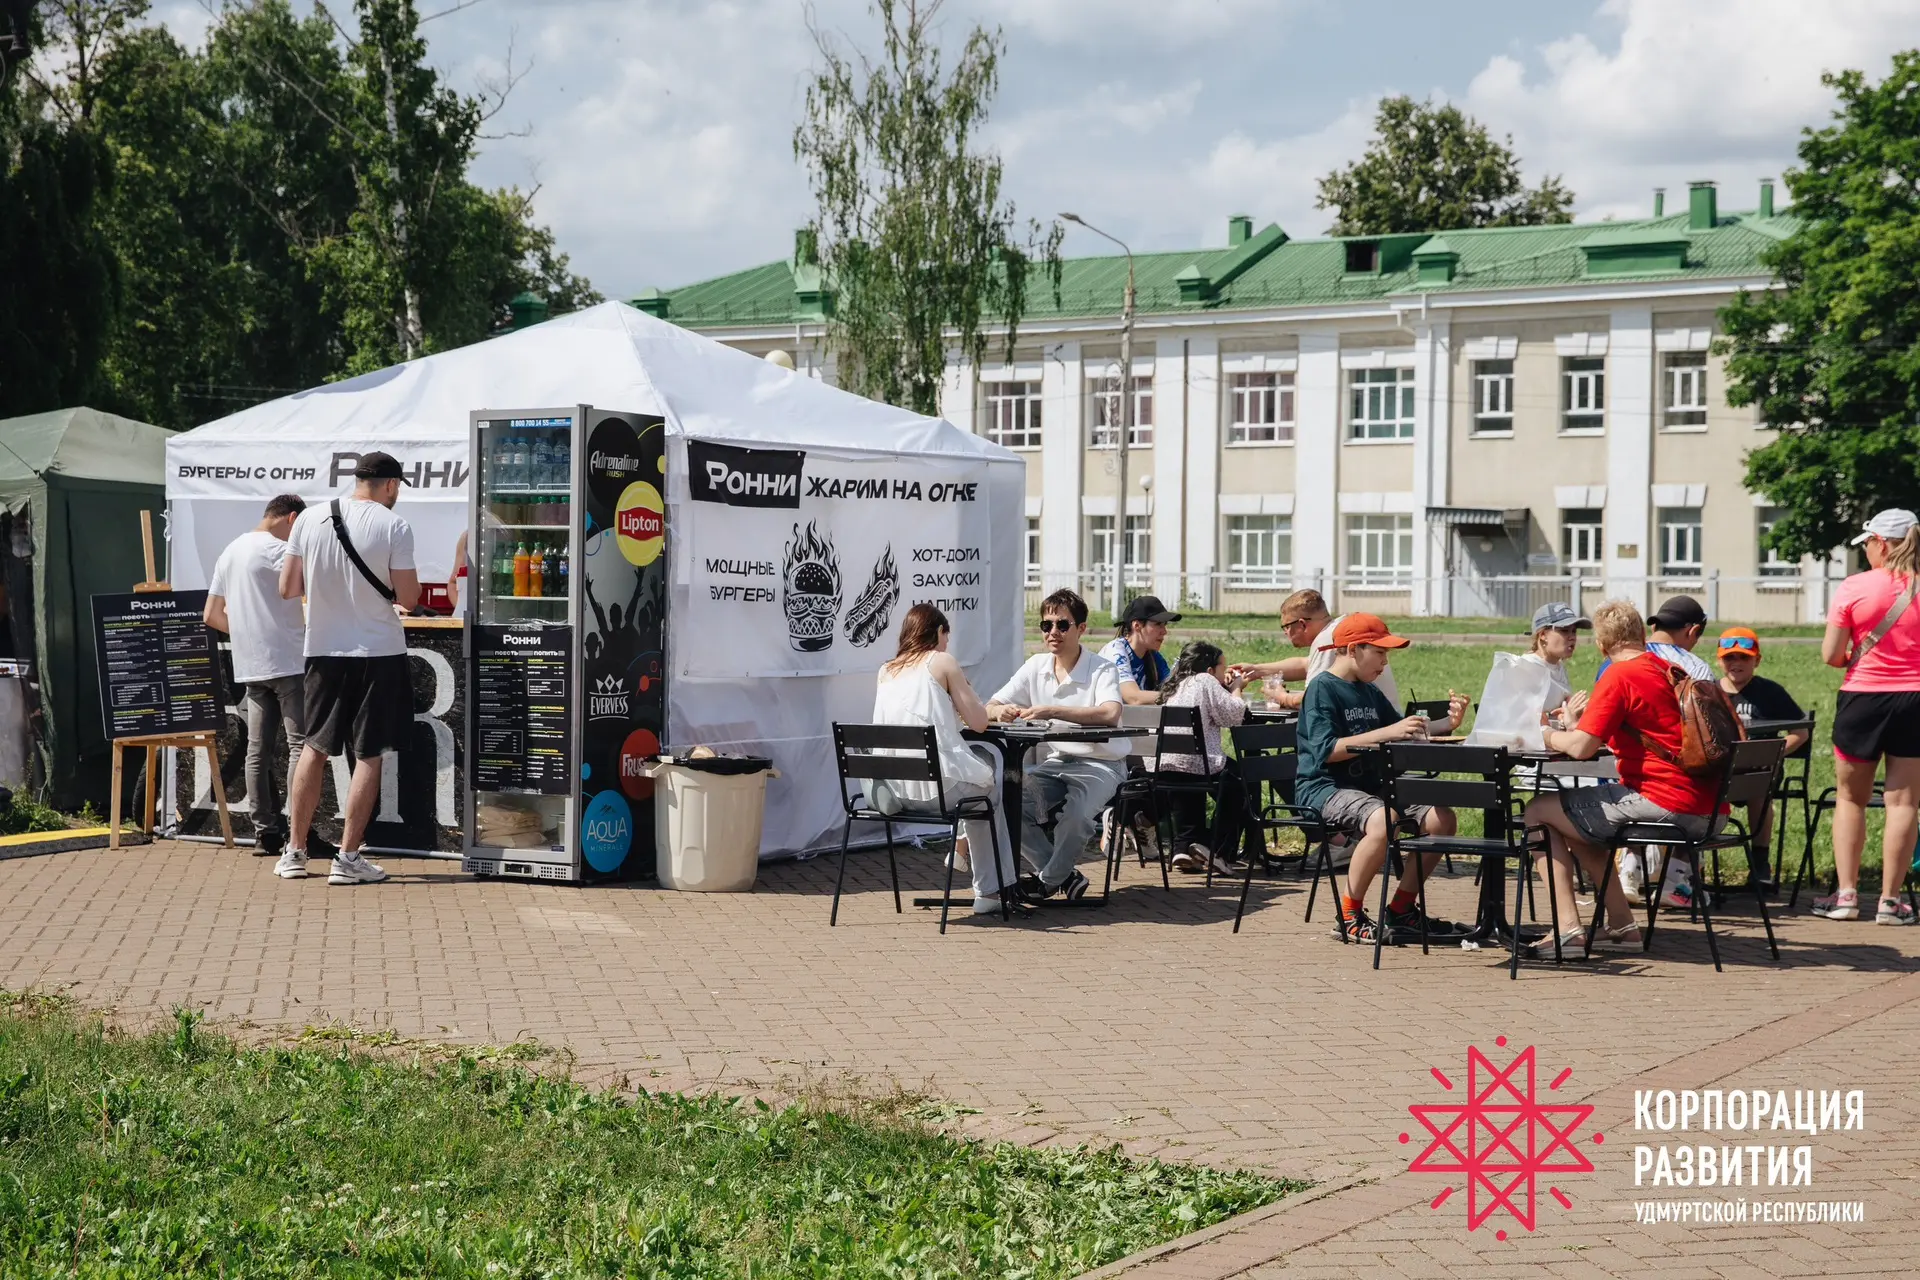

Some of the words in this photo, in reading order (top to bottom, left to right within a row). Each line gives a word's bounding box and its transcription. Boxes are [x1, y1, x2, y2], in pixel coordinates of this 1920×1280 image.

[590, 450, 639, 475] Adrenaline
[178, 465, 251, 479] БУРГЕРЫ
[254, 466, 266, 480] С
[270, 467, 316, 480] ОГНЯ
[606, 470, 625, 478] RUSH
[805, 475, 888, 499] ЖАРИМ
[892, 479, 922, 501] НА
[928, 482, 978, 503] ОГНЕ
[622, 514, 659, 534] Lipton
[912, 548, 980, 563] ХОТ-ДОГИ
[706, 558, 776, 577] МОЩНЫЕ
[912, 572, 980, 587] ЗАКУСКИ
[710, 586, 776, 603] БУРГЕРЫ
[590, 695, 630, 716] EVERVESS
[586, 816, 628, 843] AQUA
[590, 843, 625, 852] MINERALE
